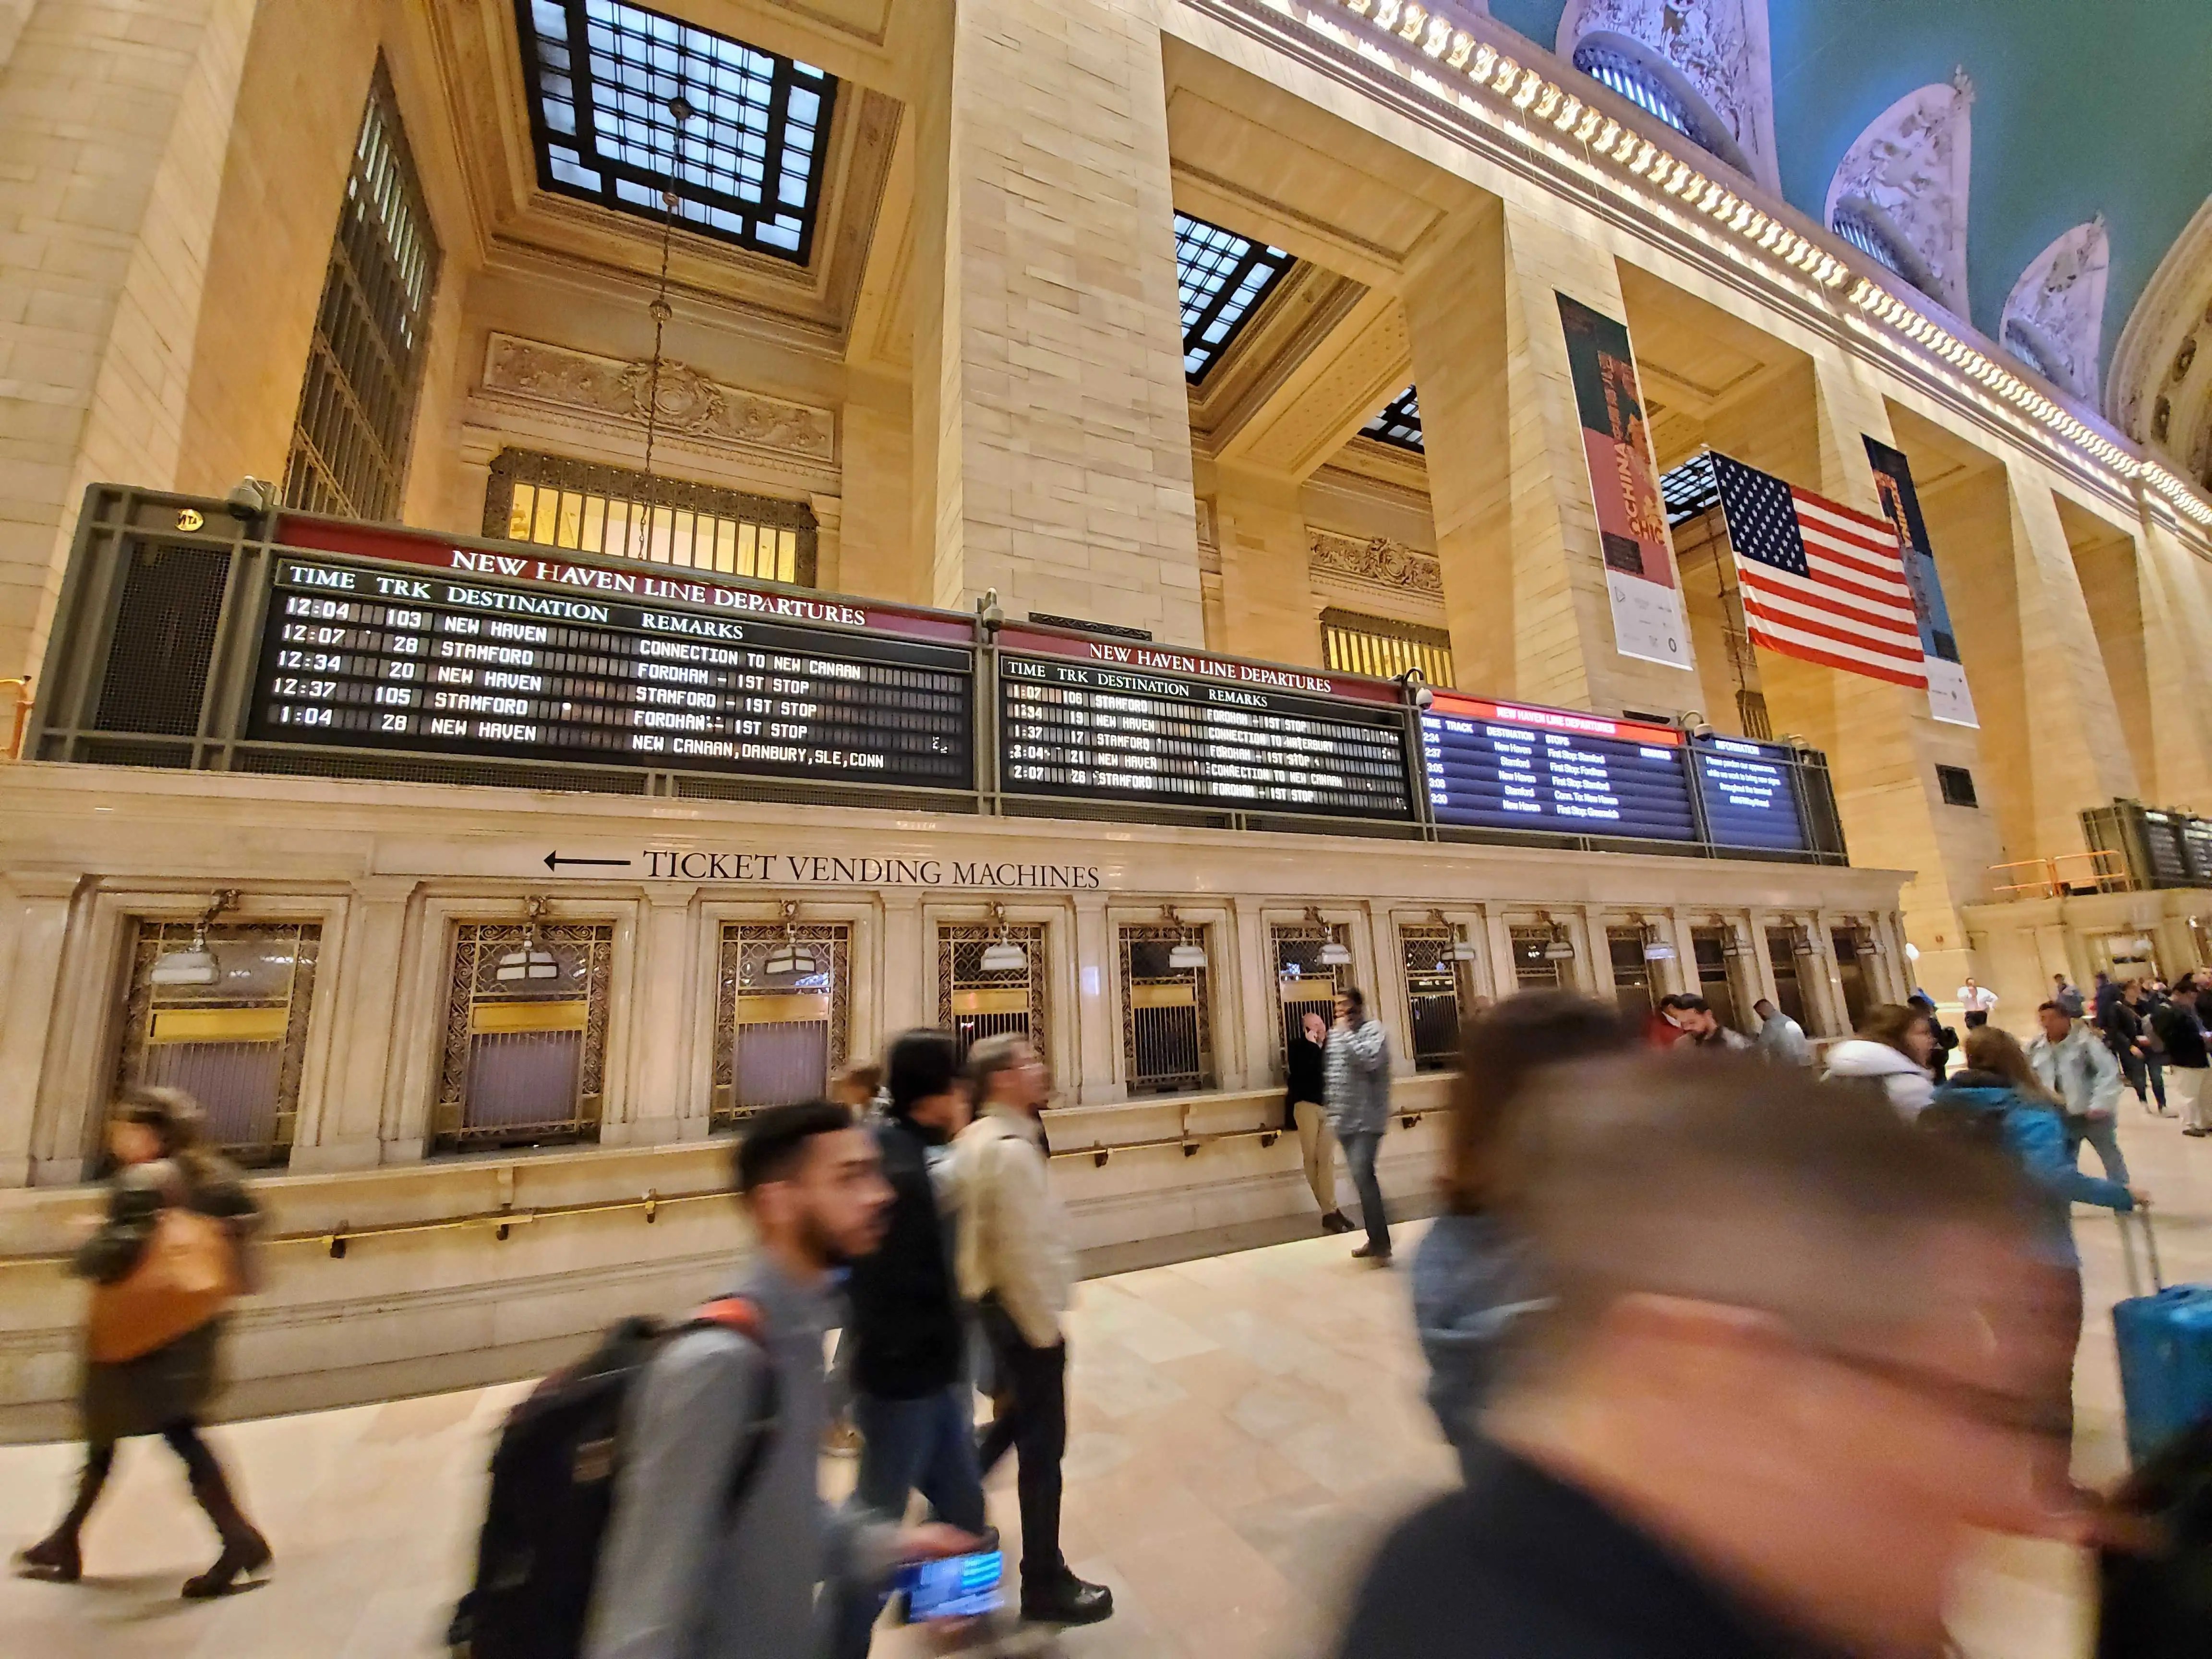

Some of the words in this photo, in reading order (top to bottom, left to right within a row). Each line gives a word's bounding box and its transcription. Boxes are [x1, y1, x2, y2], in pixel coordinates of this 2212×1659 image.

[1614, 443, 1638, 517] CHINA
[177, 512, 197, 525] MTA
[1628, 518, 1665, 545] CHIC
[290, 566, 356, 589] TIME
[376, 577, 431, 599] TRK
[447, 586, 610, 623] DESTINATION
[641, 613, 743, 640] REMARKS
[451, 550, 528, 576] NEW
[536, 562, 636, 595] HAVEN
[644, 580, 706, 604] LINE
[714, 588, 866, 626] DEPARTURES
[287, 597, 349, 620] 12:04
[387, 608, 421, 627] 103
[444, 616, 480, 634] NEW
[491, 621, 547, 642] HAVEN
[639, 640, 738, 665] CONNECTION
[747, 653, 765, 669] TO
[773, 656, 801, 672] NEW
[809, 660, 861, 679] CANAAN
[283, 624, 346, 644] 12:07
[393, 636, 419, 653] 28
[441, 641, 534, 666] STAMFORD
[637, 663, 709, 684] FORDHAM
[737, 674, 765, 690] 1ST
[773, 679, 809, 695] STOP
[1090, 643, 1132, 662] NEW
[1137, 650, 1195, 673] HAVEN
[1200, 661, 1235, 678] LINE
[1240, 666, 1331, 693] DEPARTURES
[279, 650, 341, 672] 12:34
[389, 661, 415, 678] 20
[437, 666, 473, 684] NEW
[484, 672, 542, 691] HAVEN
[636, 686, 716, 709] STAMFORD
[746, 697, 772, 713] 1ST
[781, 702, 817, 717] STOP
[1008, 661, 1046, 678] TIME
[1057, 668, 1089, 683] TRK
[1097, 673, 1190, 697] DESTINATION
[1209, 689, 1268, 707] REMARKS
[274, 677, 337, 697] 12:37
[375, 686, 411, 705] 105
[434, 692, 528, 715] STAMFORD
[735, 720, 762, 735] 1ST
[770, 723, 808, 739] STOP
[1014, 684, 1042, 700] 1:07
[1063, 690, 1082, 704] 106
[1095, 696, 1148, 713] STAMFORD
[1207, 709, 1248, 725] FORDHAM
[1264, 716, 1280, 728] 1ST
[1285, 719, 1307, 732] STOP
[1014, 704, 1042, 720] 1:34
[1070, 711, 1083, 724] 19
[1096, 714, 1116, 728] NEW
[1122, 717, 1154, 732] HAVEN
[1208, 727, 1266, 745] CONNECTION
[1270, 734, 1282, 745] TO
[1496, 706, 1515, 719] NEW
[1518, 709, 1545, 723] HAVEN
[1546, 715, 1564, 726] LINE
[1565, 717, 1615, 733] DEPARTURES
[281, 706, 333, 725] 1:04
[382, 714, 407, 731] 28
[431, 718, 467, 735] NEW
[478, 721, 537, 742] HAVEN
[632, 734, 664, 751] NEW
[1015, 724, 1043, 741] 1:37
[1071, 731, 1084, 745] 17
[1097, 733, 1150, 751] STAMFORD
[1210, 745, 1250, 760] FORDHAM
[1268, 752, 1283, 764] 1ST
[1287, 753, 1310, 766] STOP
[1421, 716, 1441, 729] TIME
[1445, 720, 1474, 733] TRACK
[1487, 726, 1535, 741] DESTINATION
[1545, 733, 1570, 745] STOPS
[1494, 741, 1509, 751] New
[1510, 744, 1532, 755] Haven
[1715, 740, 1760, 755] INFORMATION
[1071, 750, 1084, 764] 21
[1098, 753, 1118, 767] NEW
[1124, 756, 1157, 771] HAVEN
[1212, 764, 1269, 780] CONNECTION
[1274, 771, 1285, 782] TO
[1290, 772, 1306, 784] NEW
[1310, 773, 1342, 787] CANAAN
[1498, 770, 1514, 781] New
[1514, 772, 1536, 783] Haven
[1500, 756, 1531, 768] Stamford
[1014, 765, 1044, 780] 2:07
[1071, 769, 1086, 784] 26
[1098, 771, 1152, 789] STAMFORD
[1213, 782, 1254, 798] FORDHAM
[1271, 787, 1286, 800] 1ST
[1291, 789, 1313, 802] STOP
[1504, 785, 1535, 797] Stamford
[1503, 799, 1518, 810] New
[1518, 801, 1541, 812] Haven
[643, 850, 776, 880] TICKET
[787, 855, 941, 884] VENDING
[952, 862, 1099, 889] MACHINES
